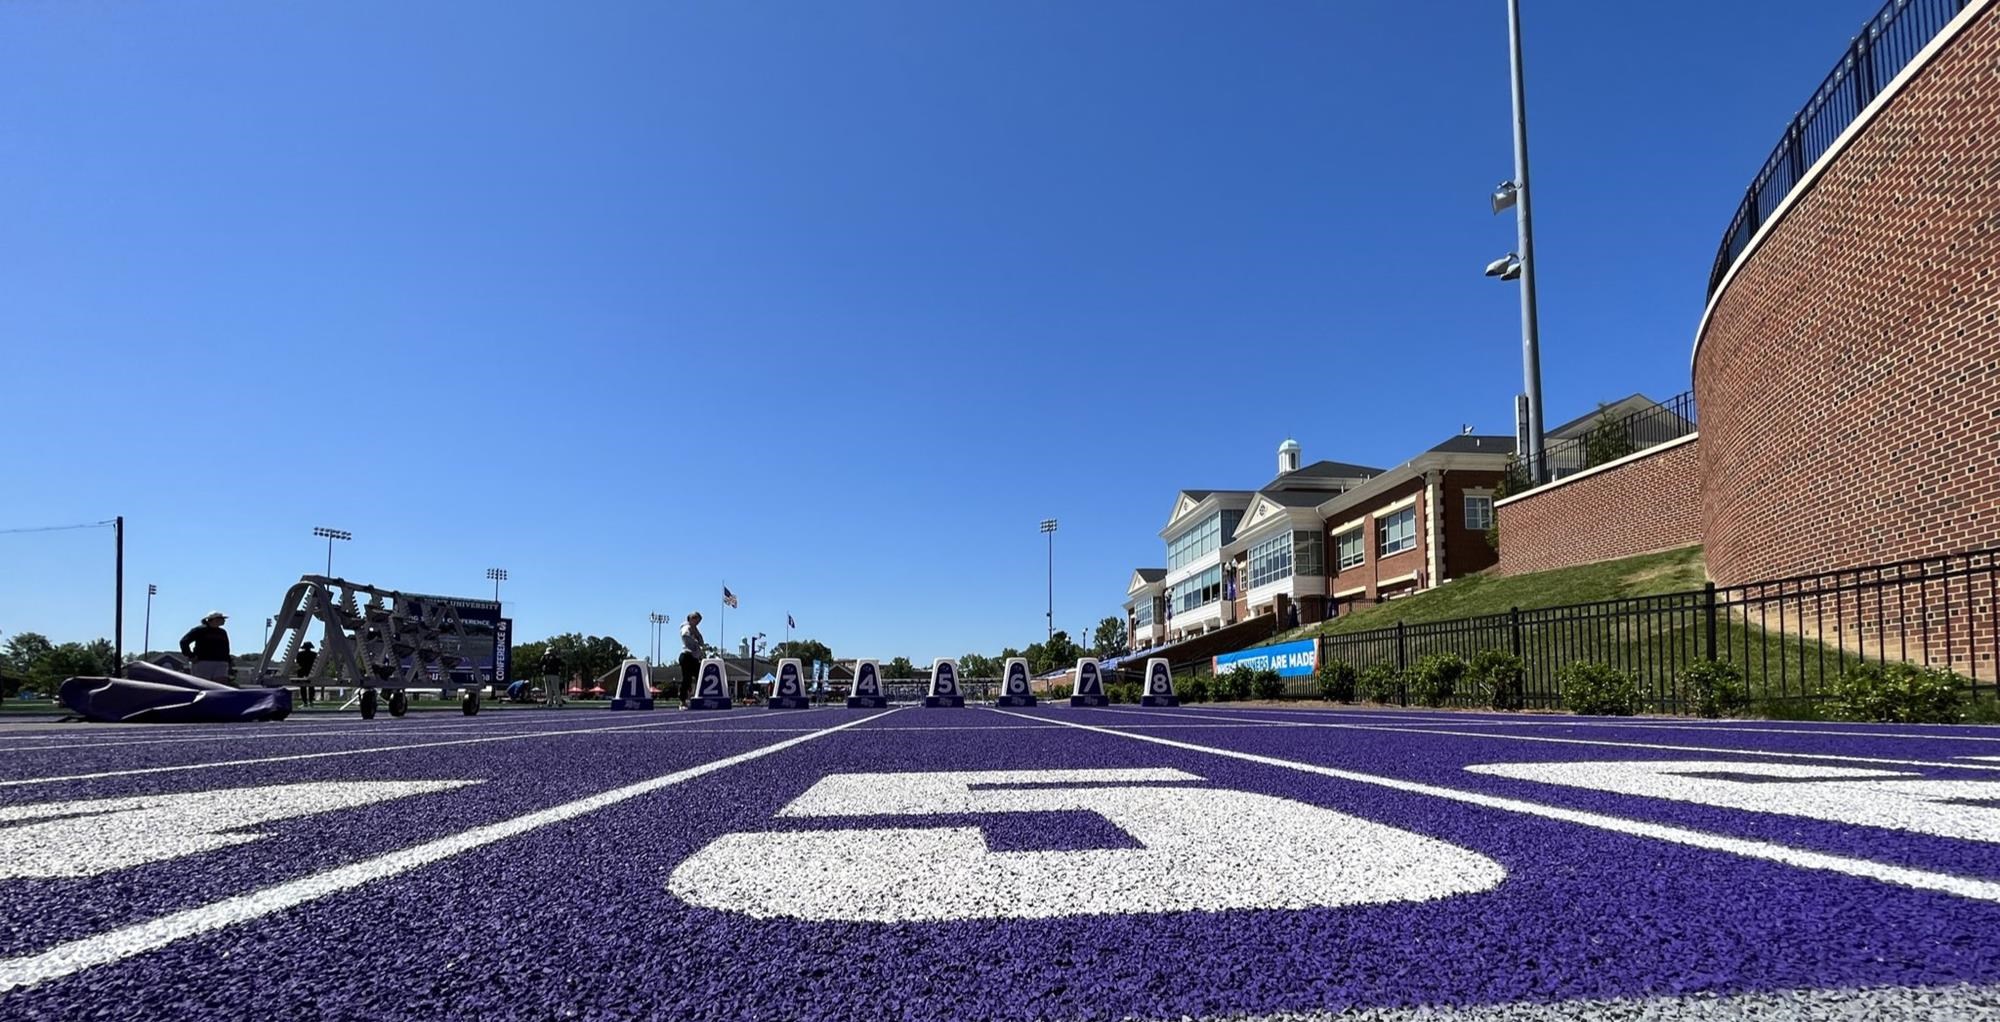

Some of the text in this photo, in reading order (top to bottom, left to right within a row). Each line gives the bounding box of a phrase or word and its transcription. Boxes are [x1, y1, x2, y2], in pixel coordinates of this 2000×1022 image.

[450, 600, 499, 611] UNIVERSITY
[496, 631, 506, 681] CONFERENCE
[1270, 653, 1288, 670] ARE
[1288, 650, 1315, 669] MADE
[627, 675, 637, 696] 1
[703, 674, 719, 695] 2
[782, 674, 797, 695] 3
[859, 674, 876, 694] 4
[938, 673, 953, 693] 5
[1010, 673, 1025, 693] 6
[1082, 673, 1096, 693] 7
[1153, 673, 1168, 693] 8
[668, 767, 1507, 923] 5
